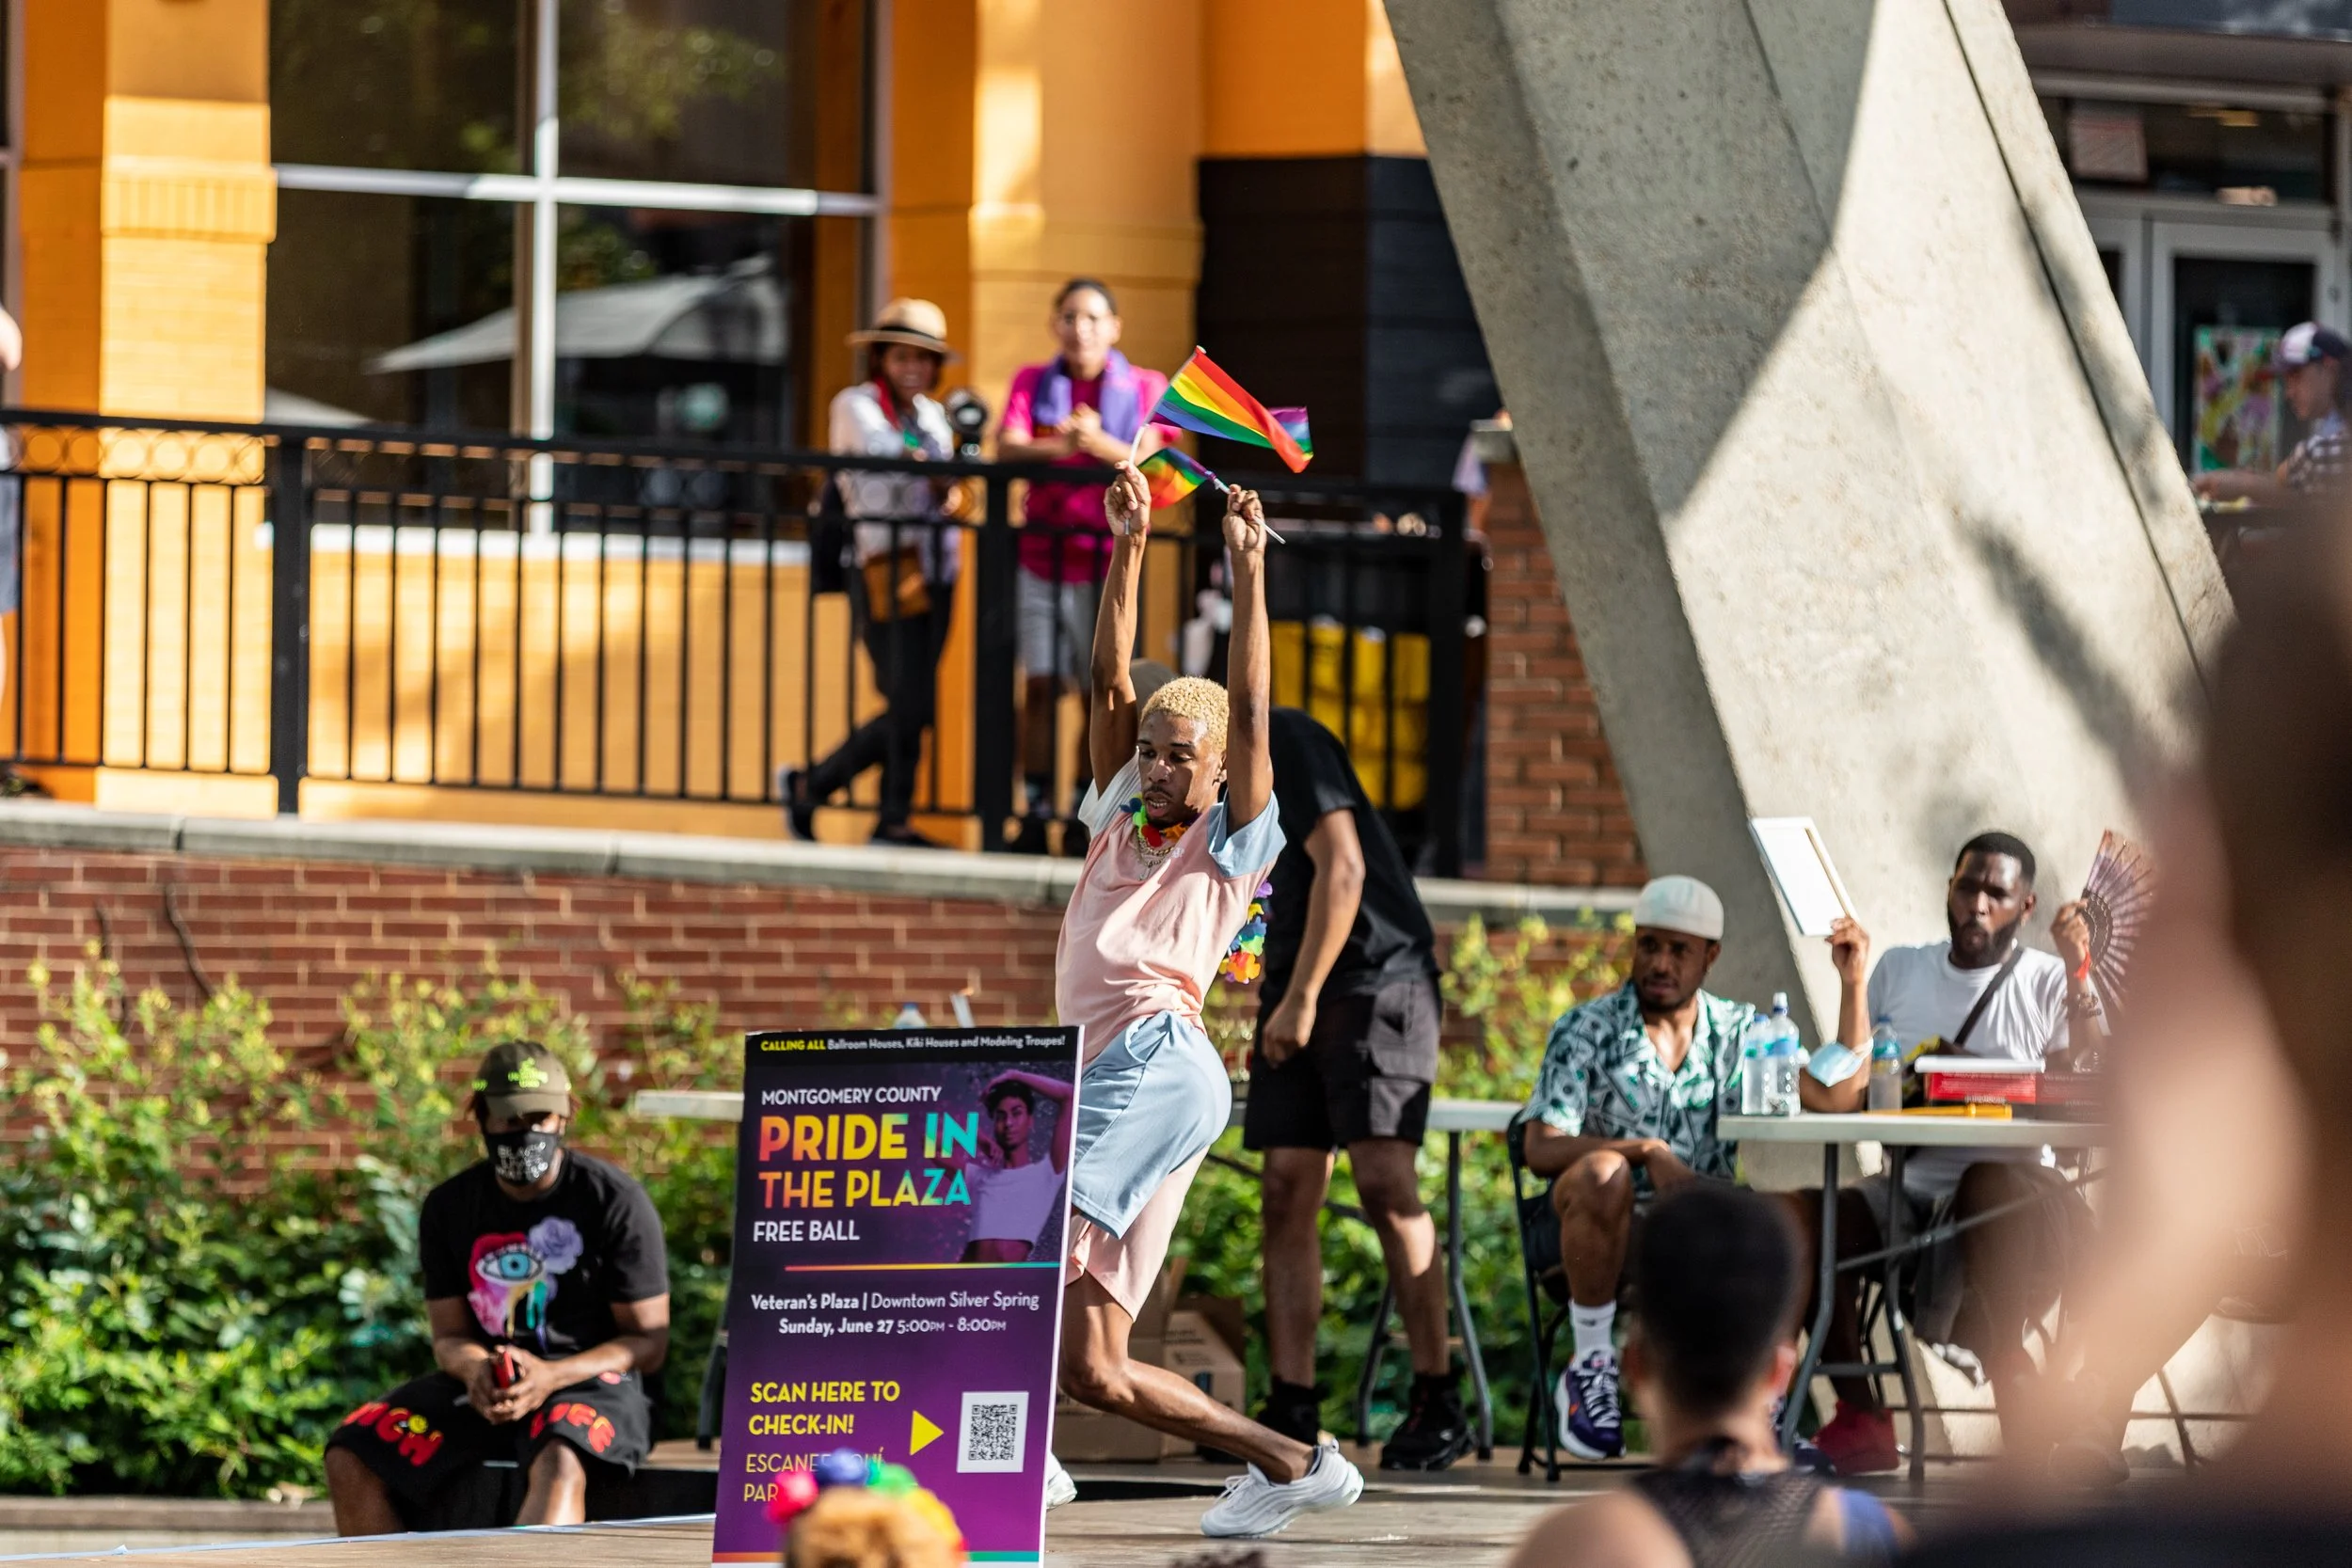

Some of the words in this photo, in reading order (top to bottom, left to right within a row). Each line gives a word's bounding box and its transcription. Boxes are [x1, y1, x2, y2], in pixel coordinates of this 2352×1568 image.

[760, 1039, 806, 1052] CALLING
[806, 1039, 827, 1051] ALL
[827, 1038, 868, 1051] Ballroom
[868, 1037, 905, 1050] Houses,
[905, 1037, 924, 1049] Kiki
[926, 1036, 960, 1049] Houses
[961, 1035, 979, 1047] and
[980, 1035, 1025, 1050] Modeling
[1025, 1034, 1067, 1048] Troupes!
[761, 1087, 873, 1105] MONTGOMERY
[875, 1085, 942, 1103] COUNTY
[758, 1113, 909, 1162] PRIDE
[924, 1112, 979, 1159] IN
[757, 1170, 834, 1209] THE
[845, 1168, 972, 1208] PLAZA
[753, 1220, 804, 1243] FREE
[809, 1219, 861, 1241] BALL
[819, 1291, 860, 1309] Plaza
[870, 1291, 946, 1308] Downtown
[948, 1290, 990, 1308] Silver
[992, 1290, 1041, 1311] Spring
[778, 1317, 835, 1338] Sunday,
[837, 1317, 874, 1333] June
[876, 1319, 895, 1334] 27
[750, 1382, 807, 1403] SCAN
[810, 1381, 866, 1402] HERE
[870, 1381, 901, 1402] TO
[748, 1414, 855, 1435] CHECK-IN!
[743, 1482, 780, 1502] PAR
